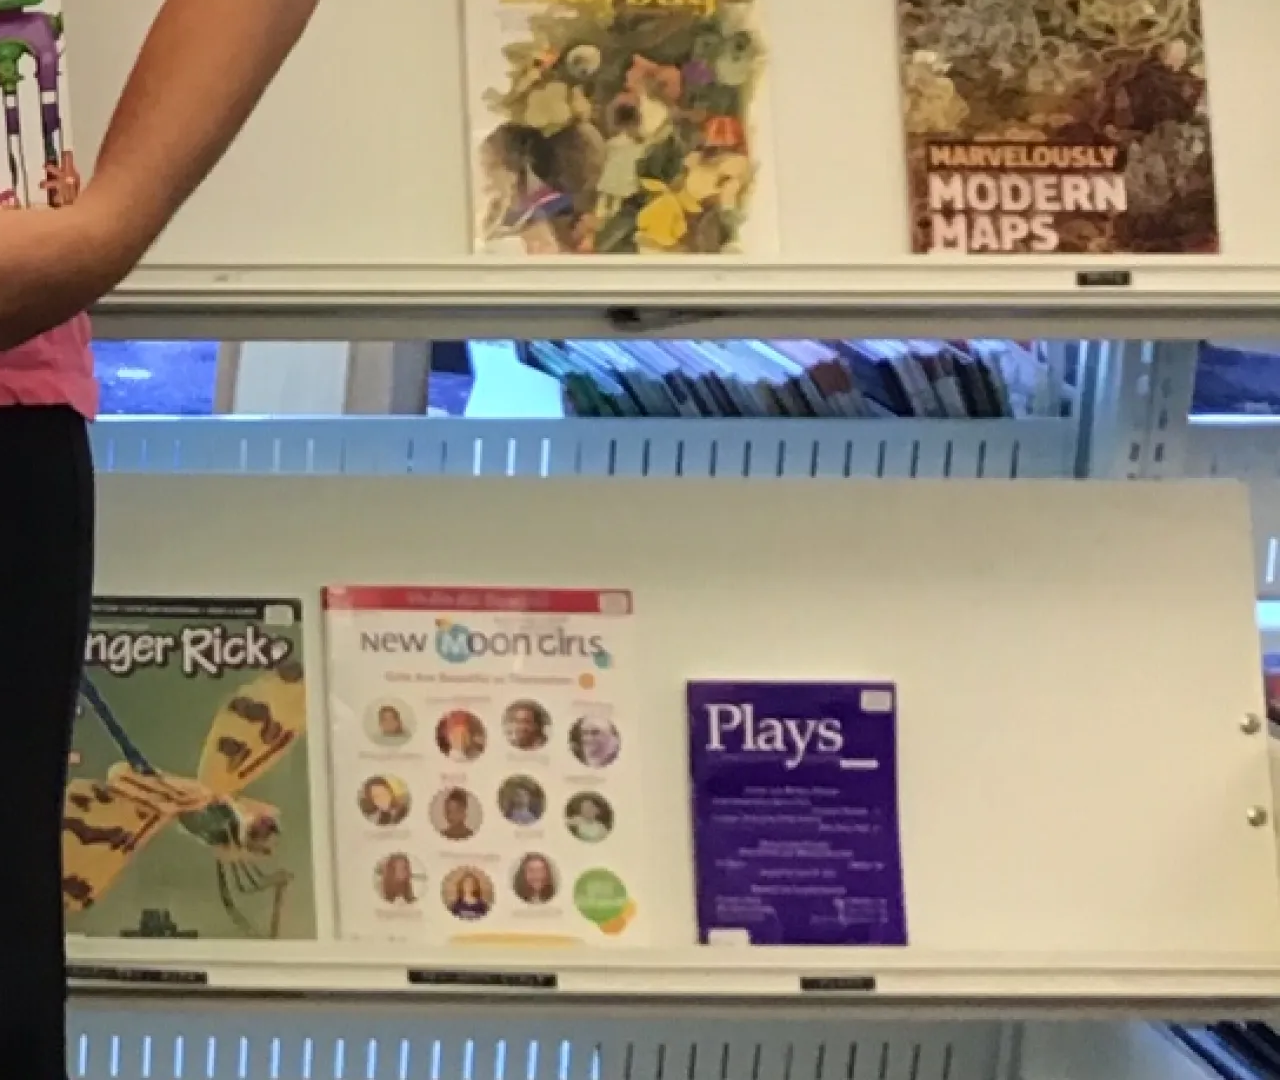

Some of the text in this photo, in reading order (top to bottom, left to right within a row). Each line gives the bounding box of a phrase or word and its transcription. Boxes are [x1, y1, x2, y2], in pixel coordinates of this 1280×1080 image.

[929, 145, 1118, 168] MARVELOUSLY
[929, 173, 1129, 212] MODERN
[930, 212, 1061, 254] MAPS
[83, 625, 270, 675] nger Rick
[359, 631, 428, 653] New
[441, 632, 532, 657] Moon
[703, 703, 844, 769] Plays
